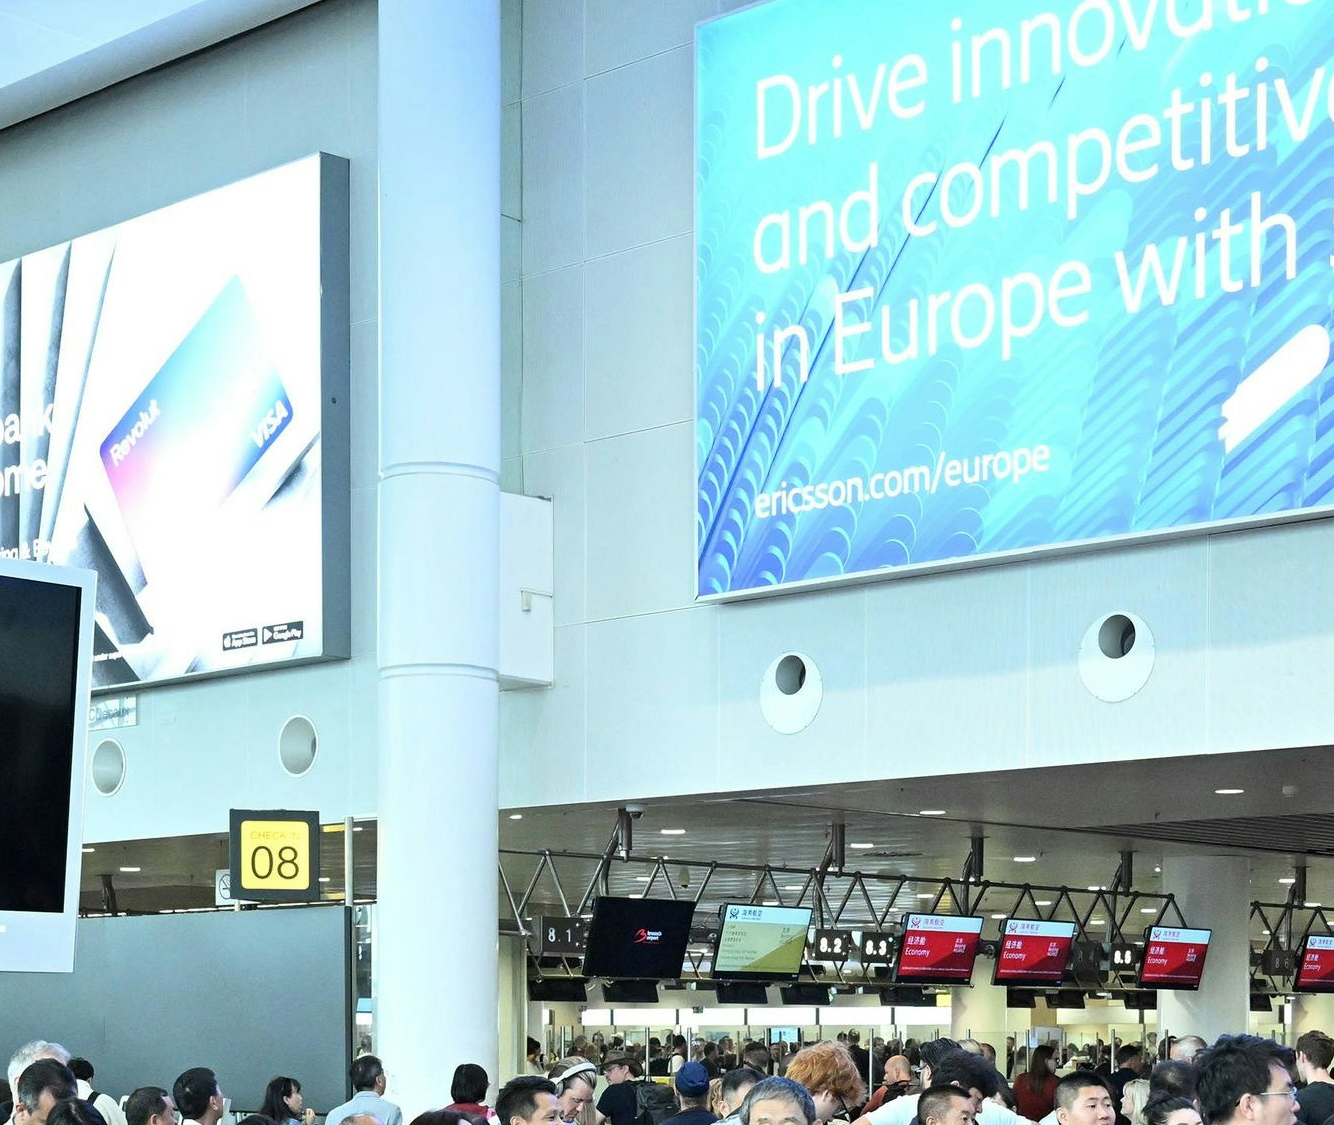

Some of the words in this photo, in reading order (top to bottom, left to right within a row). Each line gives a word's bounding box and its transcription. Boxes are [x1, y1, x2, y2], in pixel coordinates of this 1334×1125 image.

[756, 54, 928, 159] Drive
[950, 0, 1314, 103] innova
[753, 164, 879, 274] and
[754, 313, 809, 392] in
[833, 262, 1094, 374] Europe
[1116, 192, 1298, 314] with
[109, 398, 162, 468] Revolut
[251, 400, 289, 448] VISA
[752, 441, 1053, 519] ericsson.com/europe
[251, 845, 299, 880] 08
[548, 927, 572, 943] 8.1
[819, 936, 843, 954] 8.2
[905, 947, 931, 957] Economy
[1002, 952, 1027, 961] Economy
[1147, 956, 1168, 966] Economy
